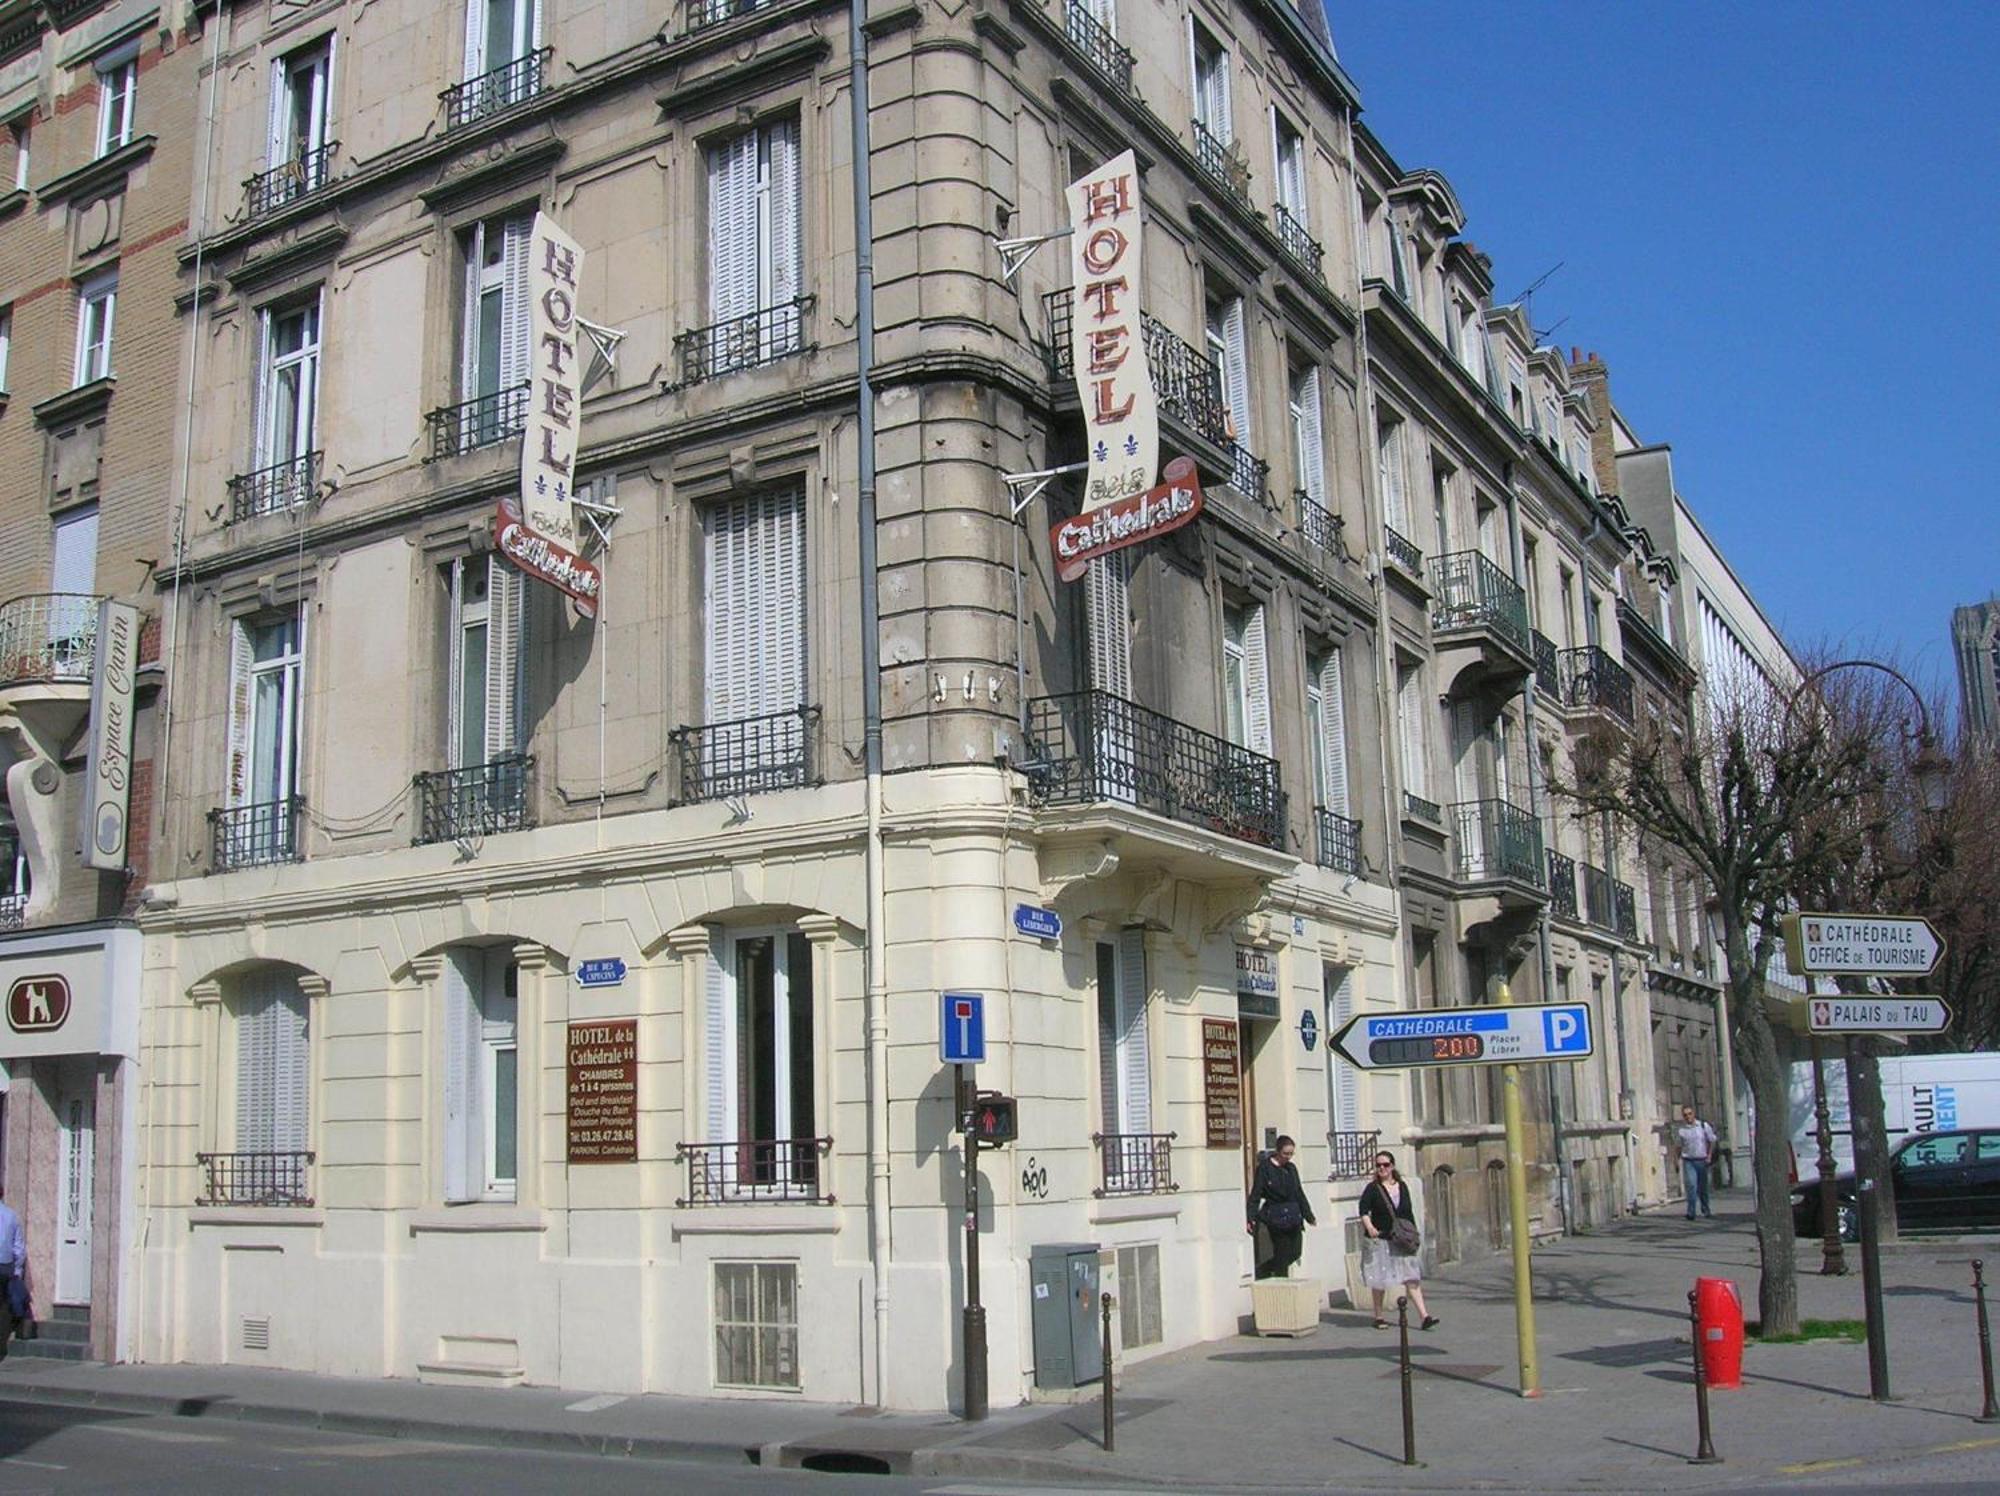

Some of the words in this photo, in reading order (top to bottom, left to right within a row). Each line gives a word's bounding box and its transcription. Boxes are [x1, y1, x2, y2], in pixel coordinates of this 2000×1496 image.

[1081, 174, 1137, 424] HOTEL
[539, 235, 576, 479] HOTEL
[105, 615, 131, 695] Canin
[99, 701, 128, 791] Espace
[1826, 921, 1913, 943] CATHÉDRALE
[1236, 951, 1270, 974] HOTEL
[1809, 947, 1849, 964] OFFICE
[1853, 953, 1863, 964] DE
[1868, 948, 1926, 965] TOURISME
[1834, 1005, 1881, 1022] PALAIS
[1904, 1006, 1928, 1022] TAU
[571, 1027, 614, 1045] HOTEL
[615, 1029, 625, 1043] de
[1374, 1018, 1473, 1036] CATHÉDRALE
[1551, 1012, 1577, 1049] P
[1433, 1037, 1478, 1059] 200
[1490, 1034, 1521, 1044] Places
[1491, 1045, 1521, 1055] Libres
[570, 1048, 622, 1066] Cathédrale
